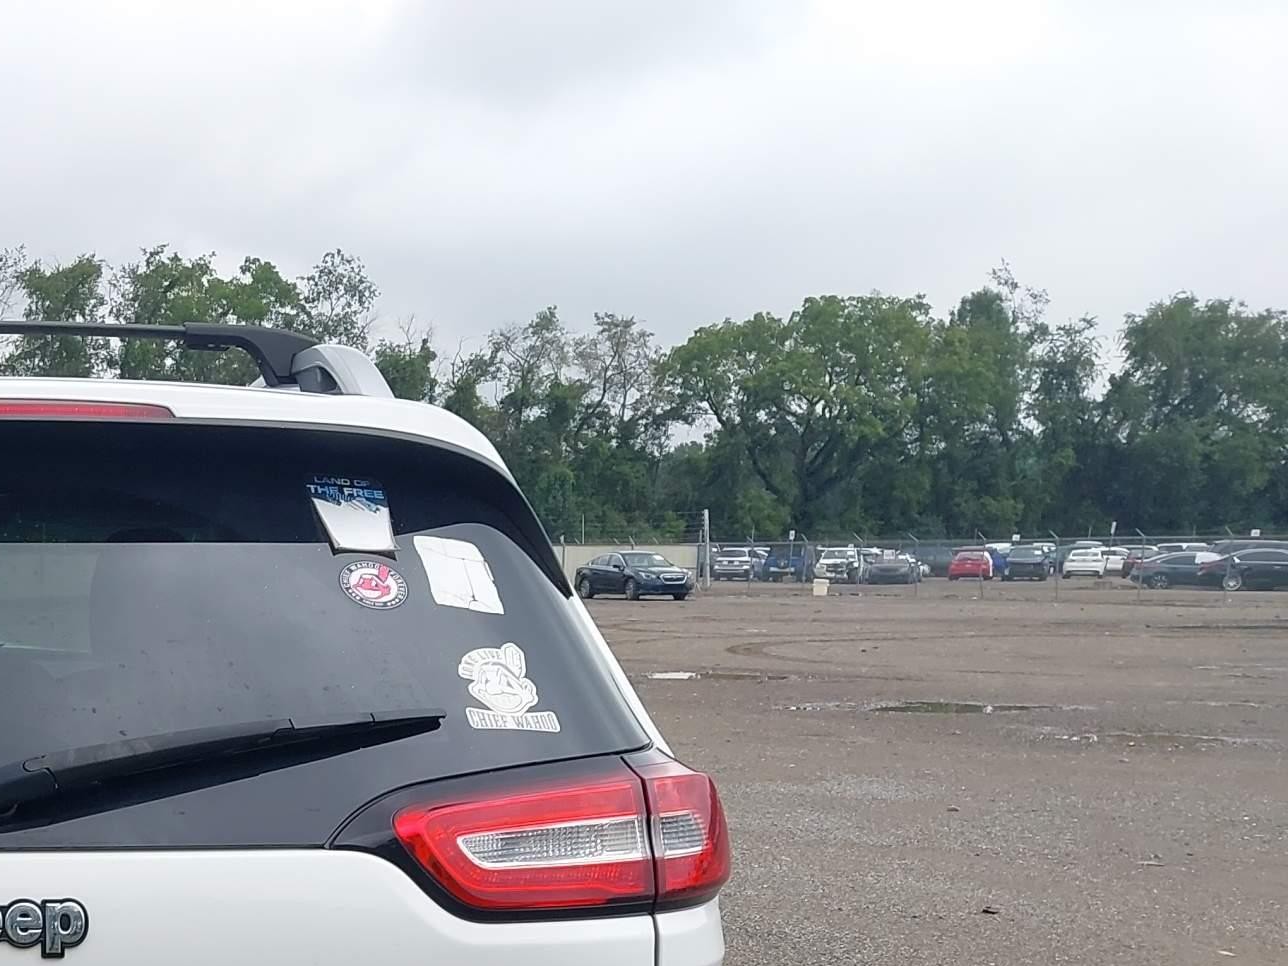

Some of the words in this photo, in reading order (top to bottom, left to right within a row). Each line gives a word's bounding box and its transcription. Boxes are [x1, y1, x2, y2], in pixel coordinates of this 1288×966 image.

[313, 476, 351, 486] LAND
[305, 484, 338, 495] THE
[342, 487, 385, 499] FREE
[468, 709, 508, 728] CHIEF
[512, 713, 558, 731] WAHOO
